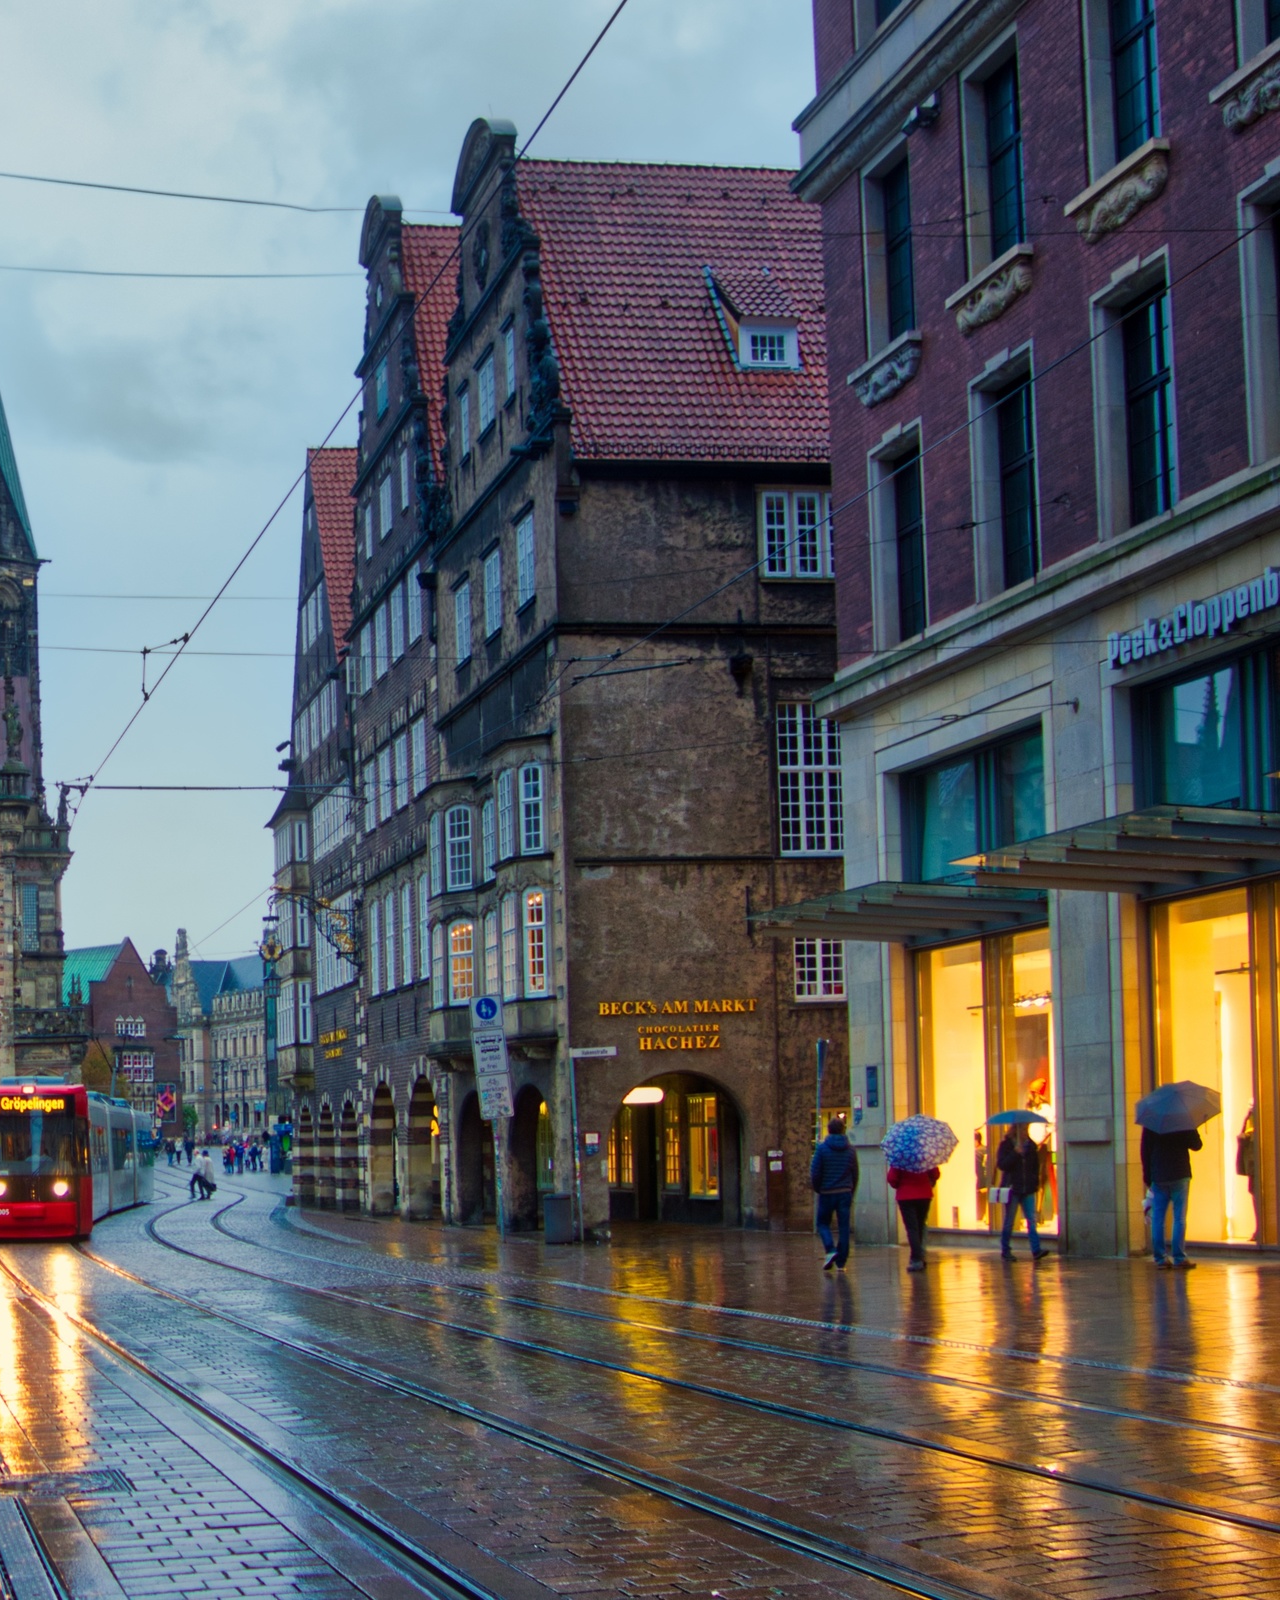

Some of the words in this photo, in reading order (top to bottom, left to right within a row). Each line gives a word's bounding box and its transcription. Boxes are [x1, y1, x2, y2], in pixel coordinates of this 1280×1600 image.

[661, 1000, 689, 1014] AM
[694, 998, 758, 1013] MARKT
[637, 1023, 720, 1034] CHOCOLATIER
[639, 1035, 721, 1051] HACHEZ
[1, 1096, 65, 1113] Gröpelingen
